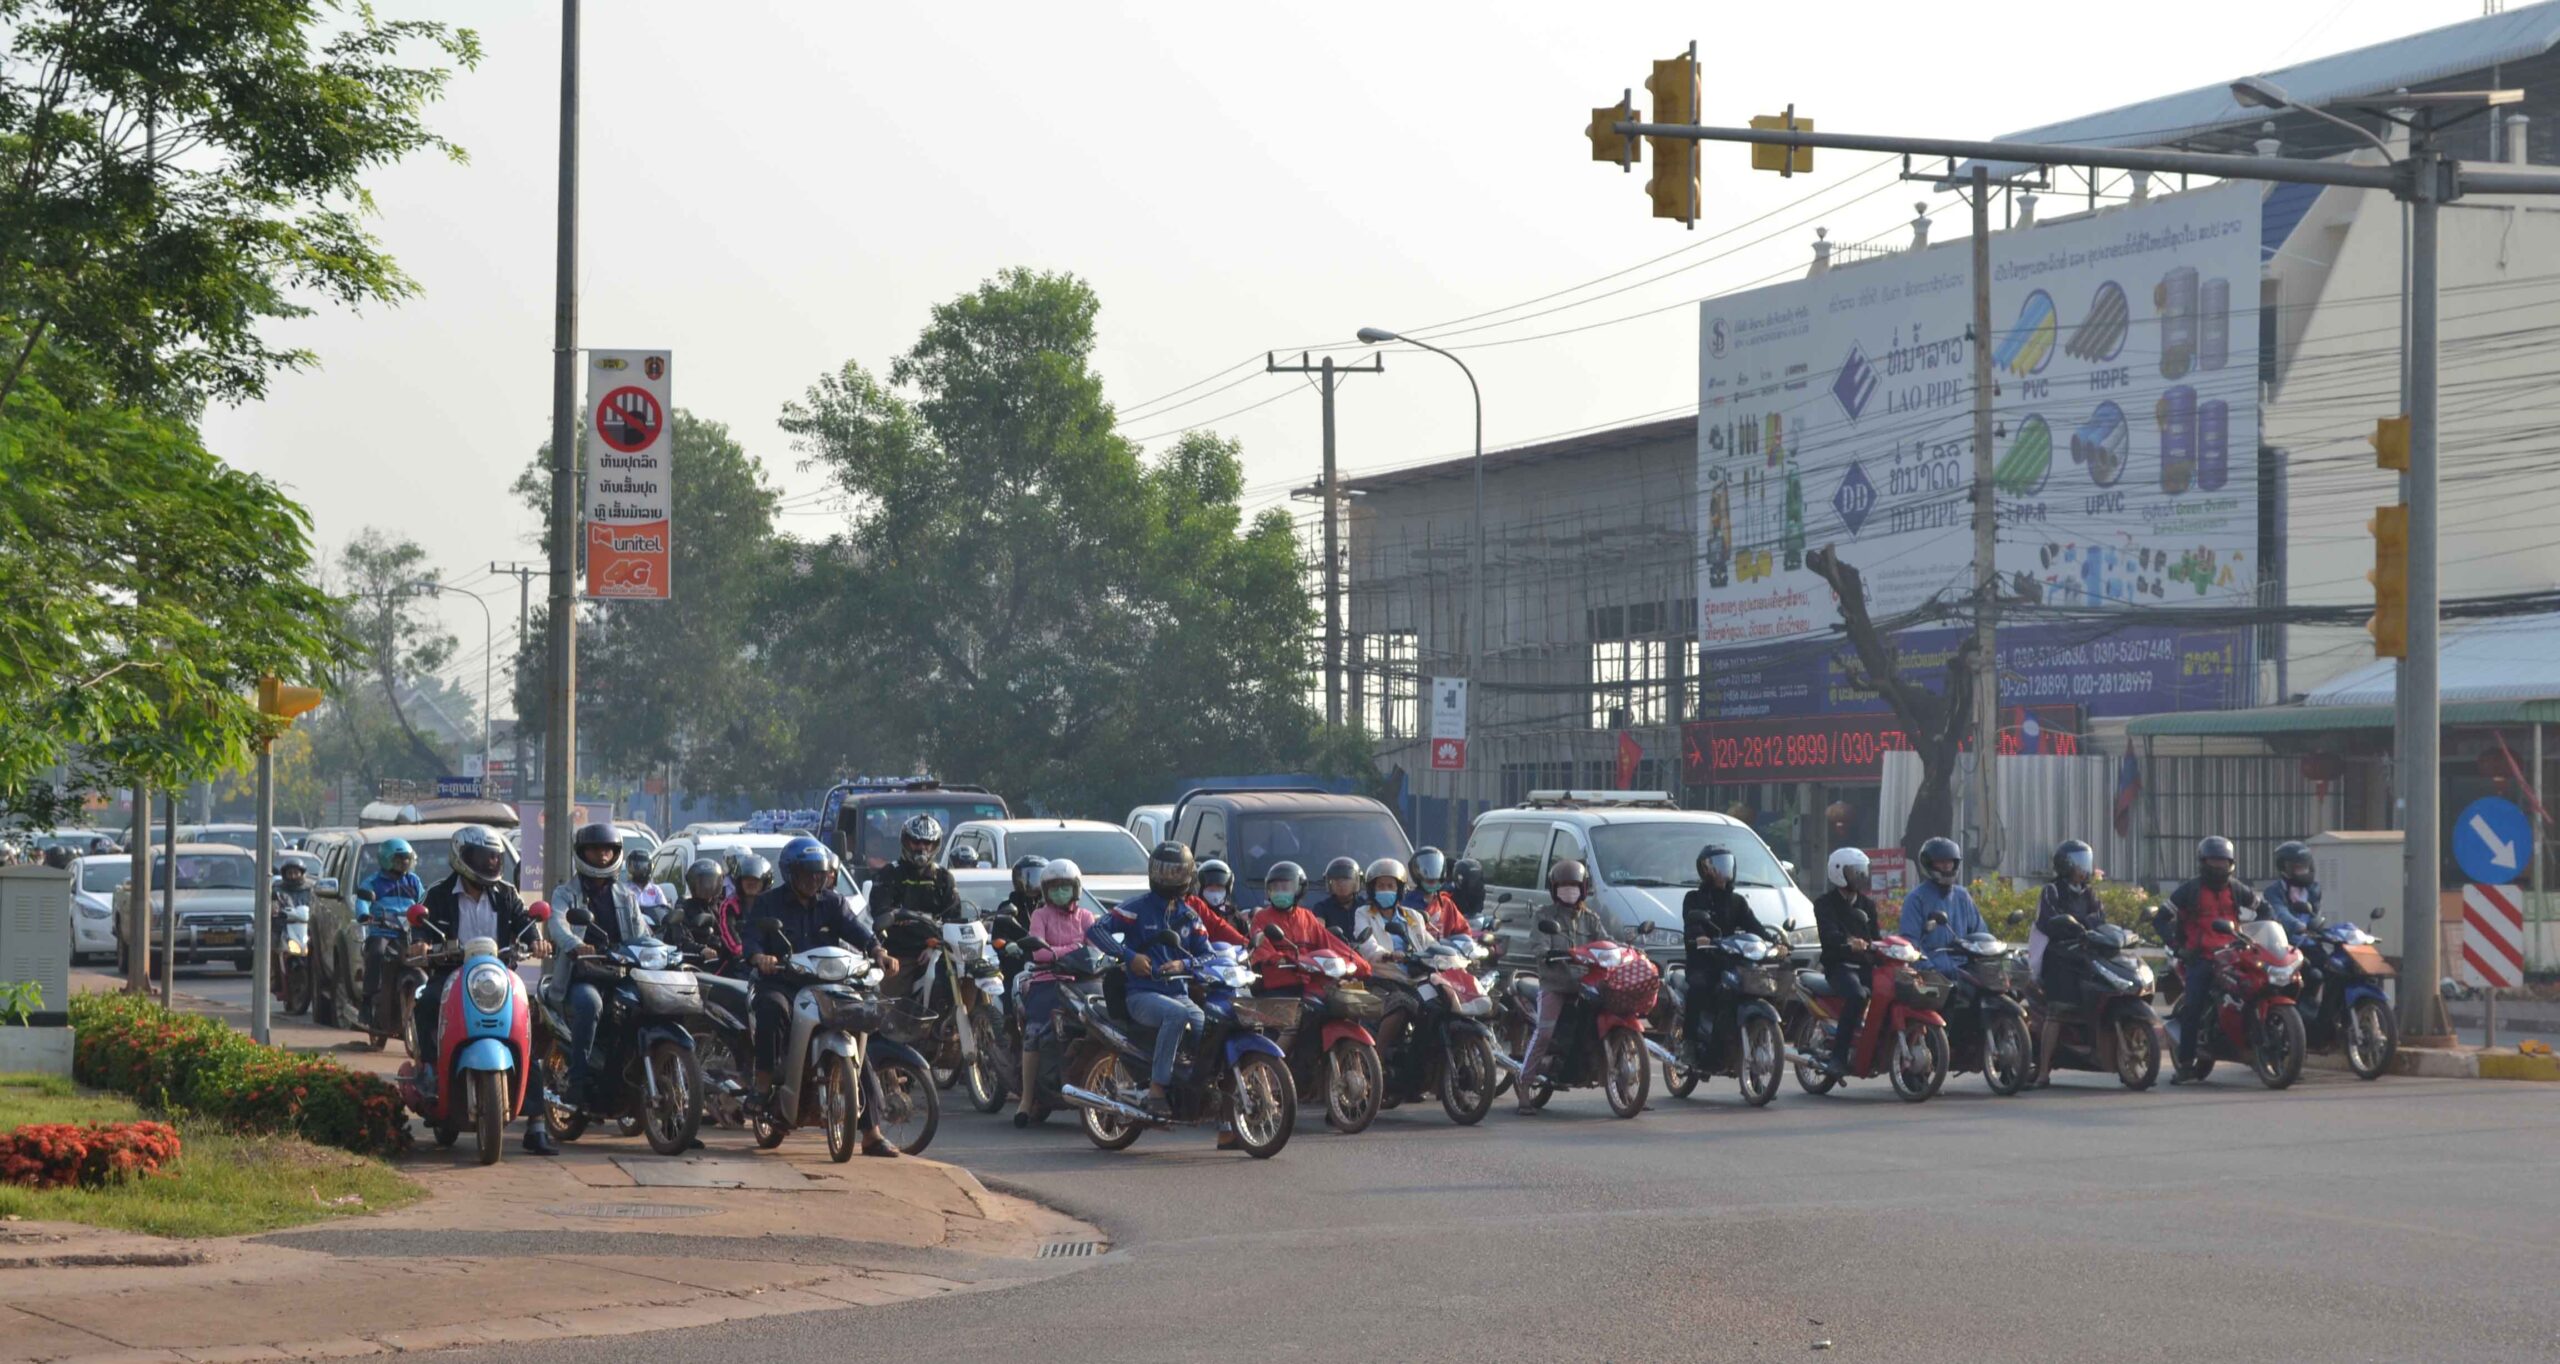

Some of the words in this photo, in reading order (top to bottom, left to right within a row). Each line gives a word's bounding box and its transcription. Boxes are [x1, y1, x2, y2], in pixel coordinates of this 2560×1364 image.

[2022, 378, 2049, 400] PVC
[2090, 366, 2129, 391] HDPE
[1887, 385, 1922, 415] LAO
[1926, 378, 1962, 409] PIPE
[1842, 483, 1869, 514] DD
[2086, 490, 2125, 515] UPVC
[1920, 501, 1960, 529] PIPE
[614, 534, 663, 552] unitel
[604, 558, 652, 587] 4G
[1787, 733, 1828, 767] 8899
